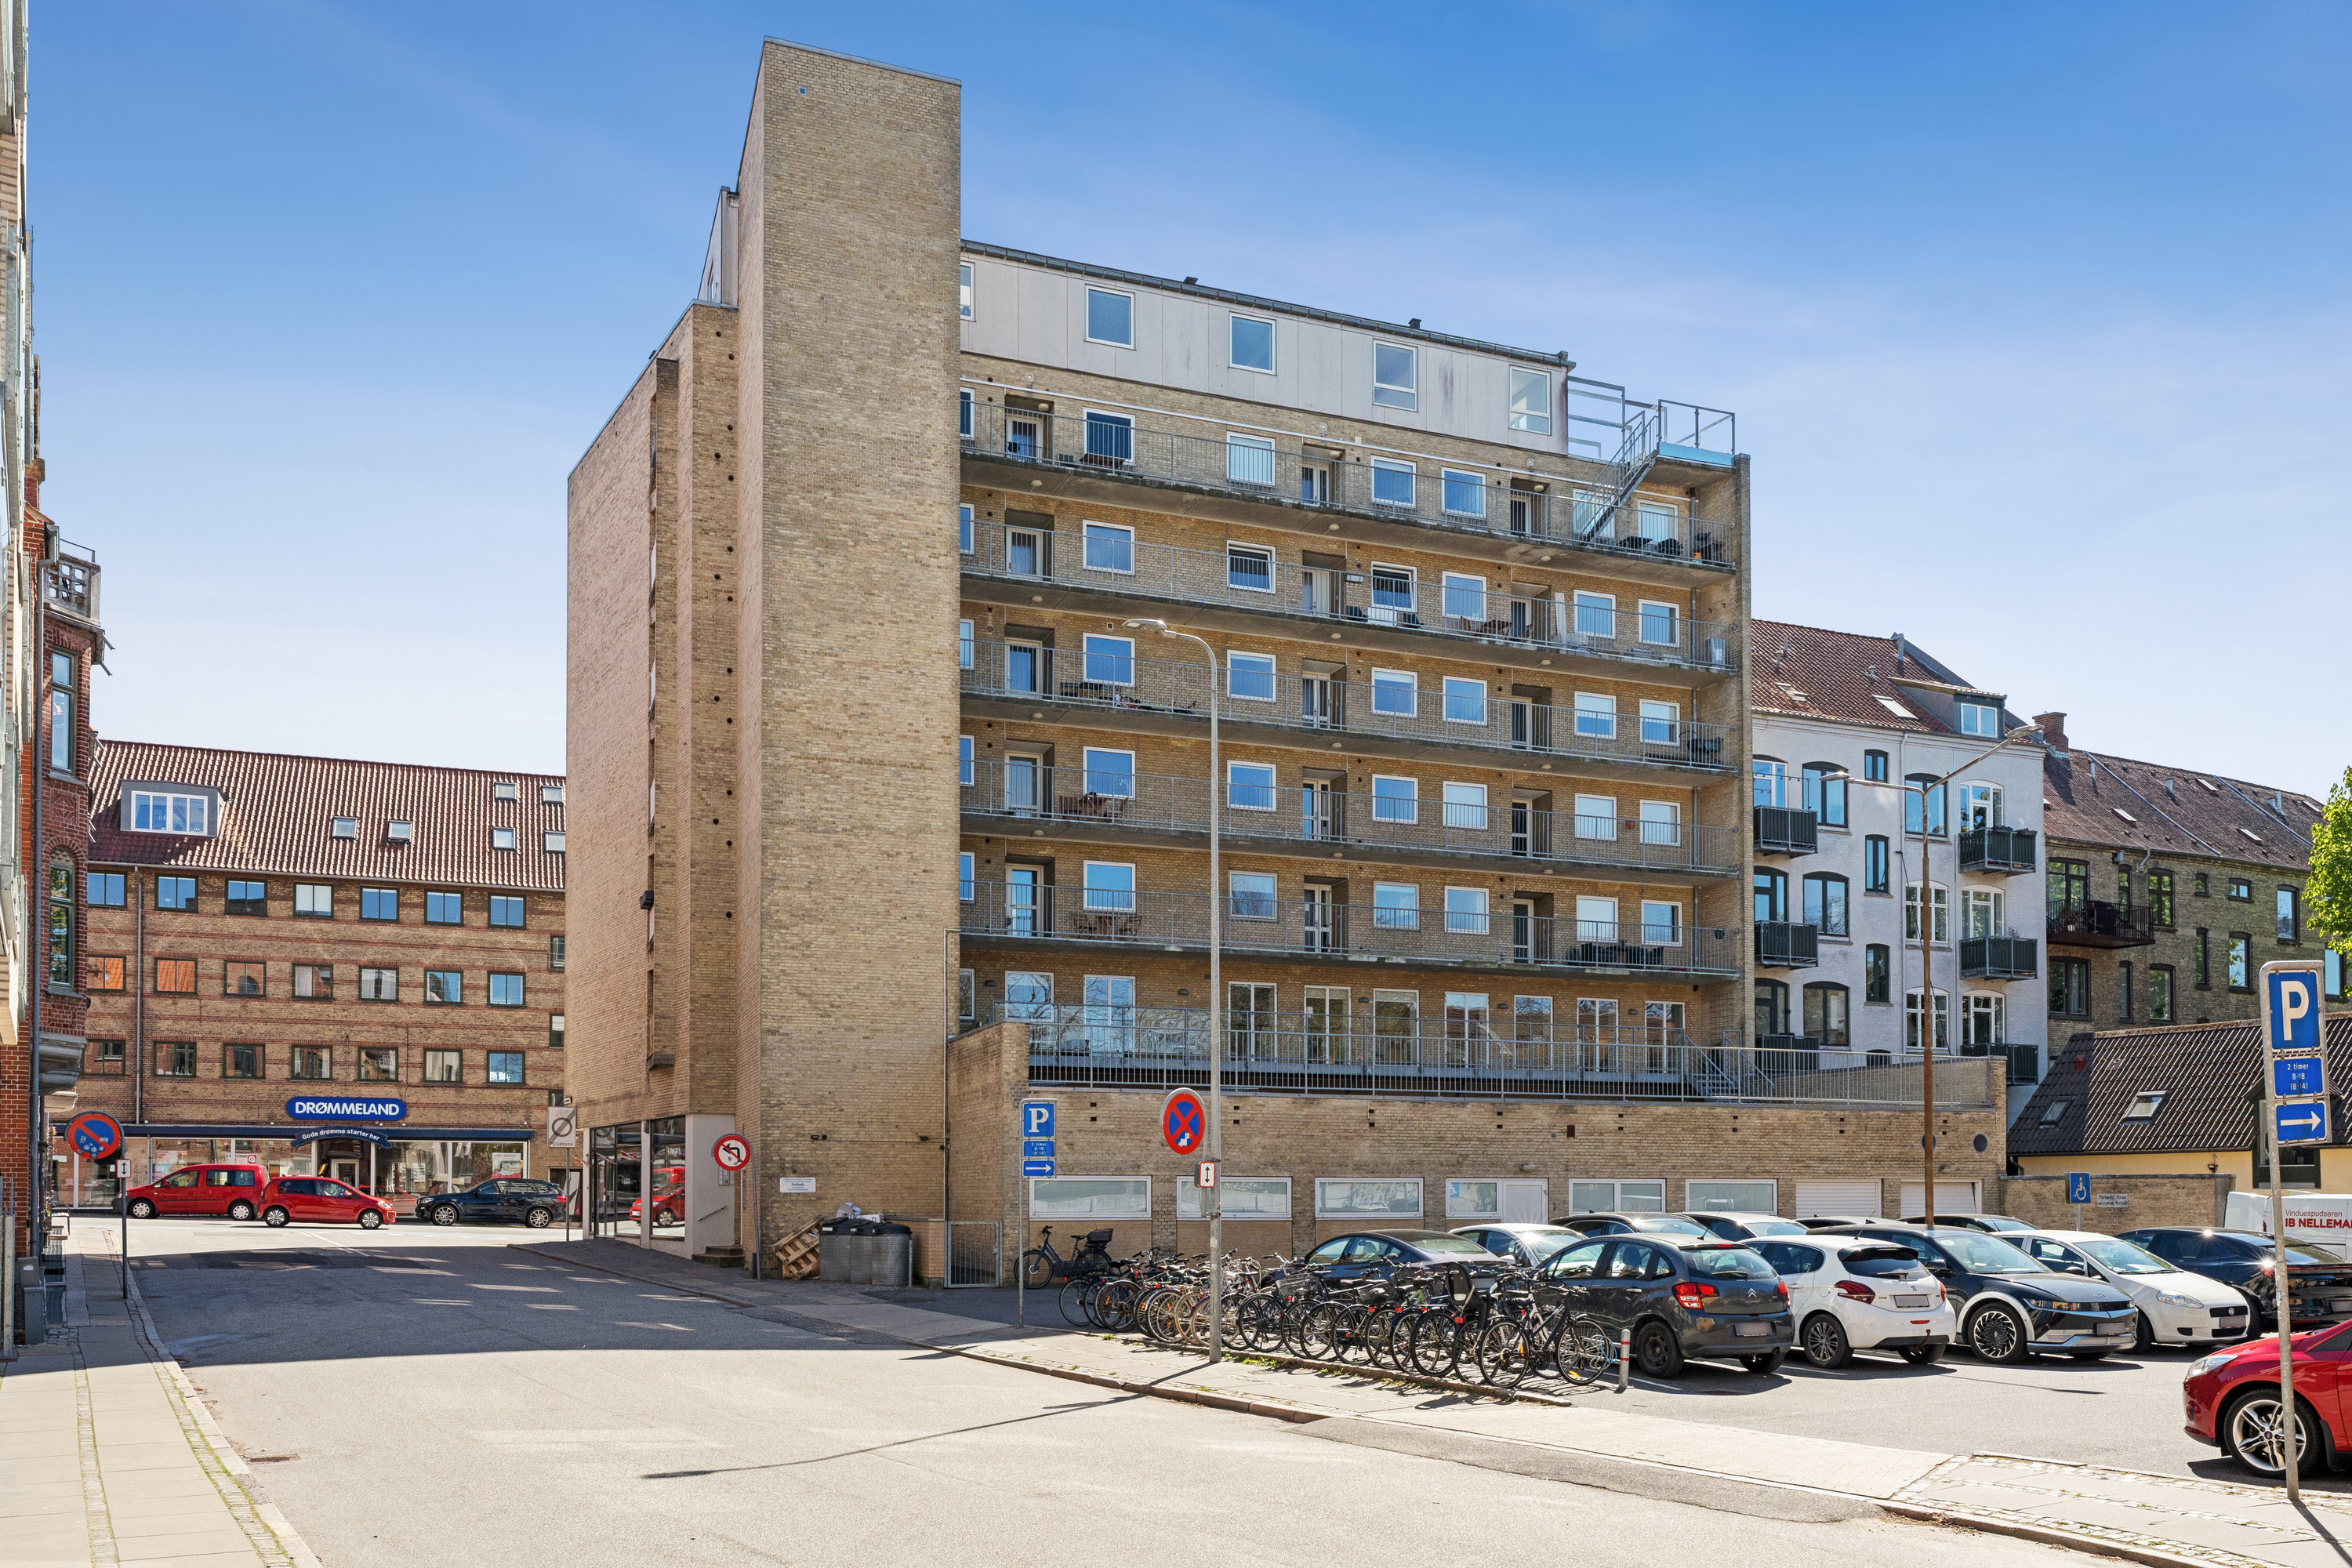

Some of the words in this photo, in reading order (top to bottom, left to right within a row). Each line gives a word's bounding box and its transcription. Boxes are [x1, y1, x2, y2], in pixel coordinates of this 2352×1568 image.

[2281, 980, 2310, 1041] P
[295, 1102, 400, 1116] DRØMMELAND
[1029, 1108, 1049, 1133] P
[302, 1131, 318, 1140] Gode
[347, 1129, 368, 1138] starter
[2285, 1218, 2296, 1228] IB
[2298, 1218, 2352, 1229] NELLEMA
